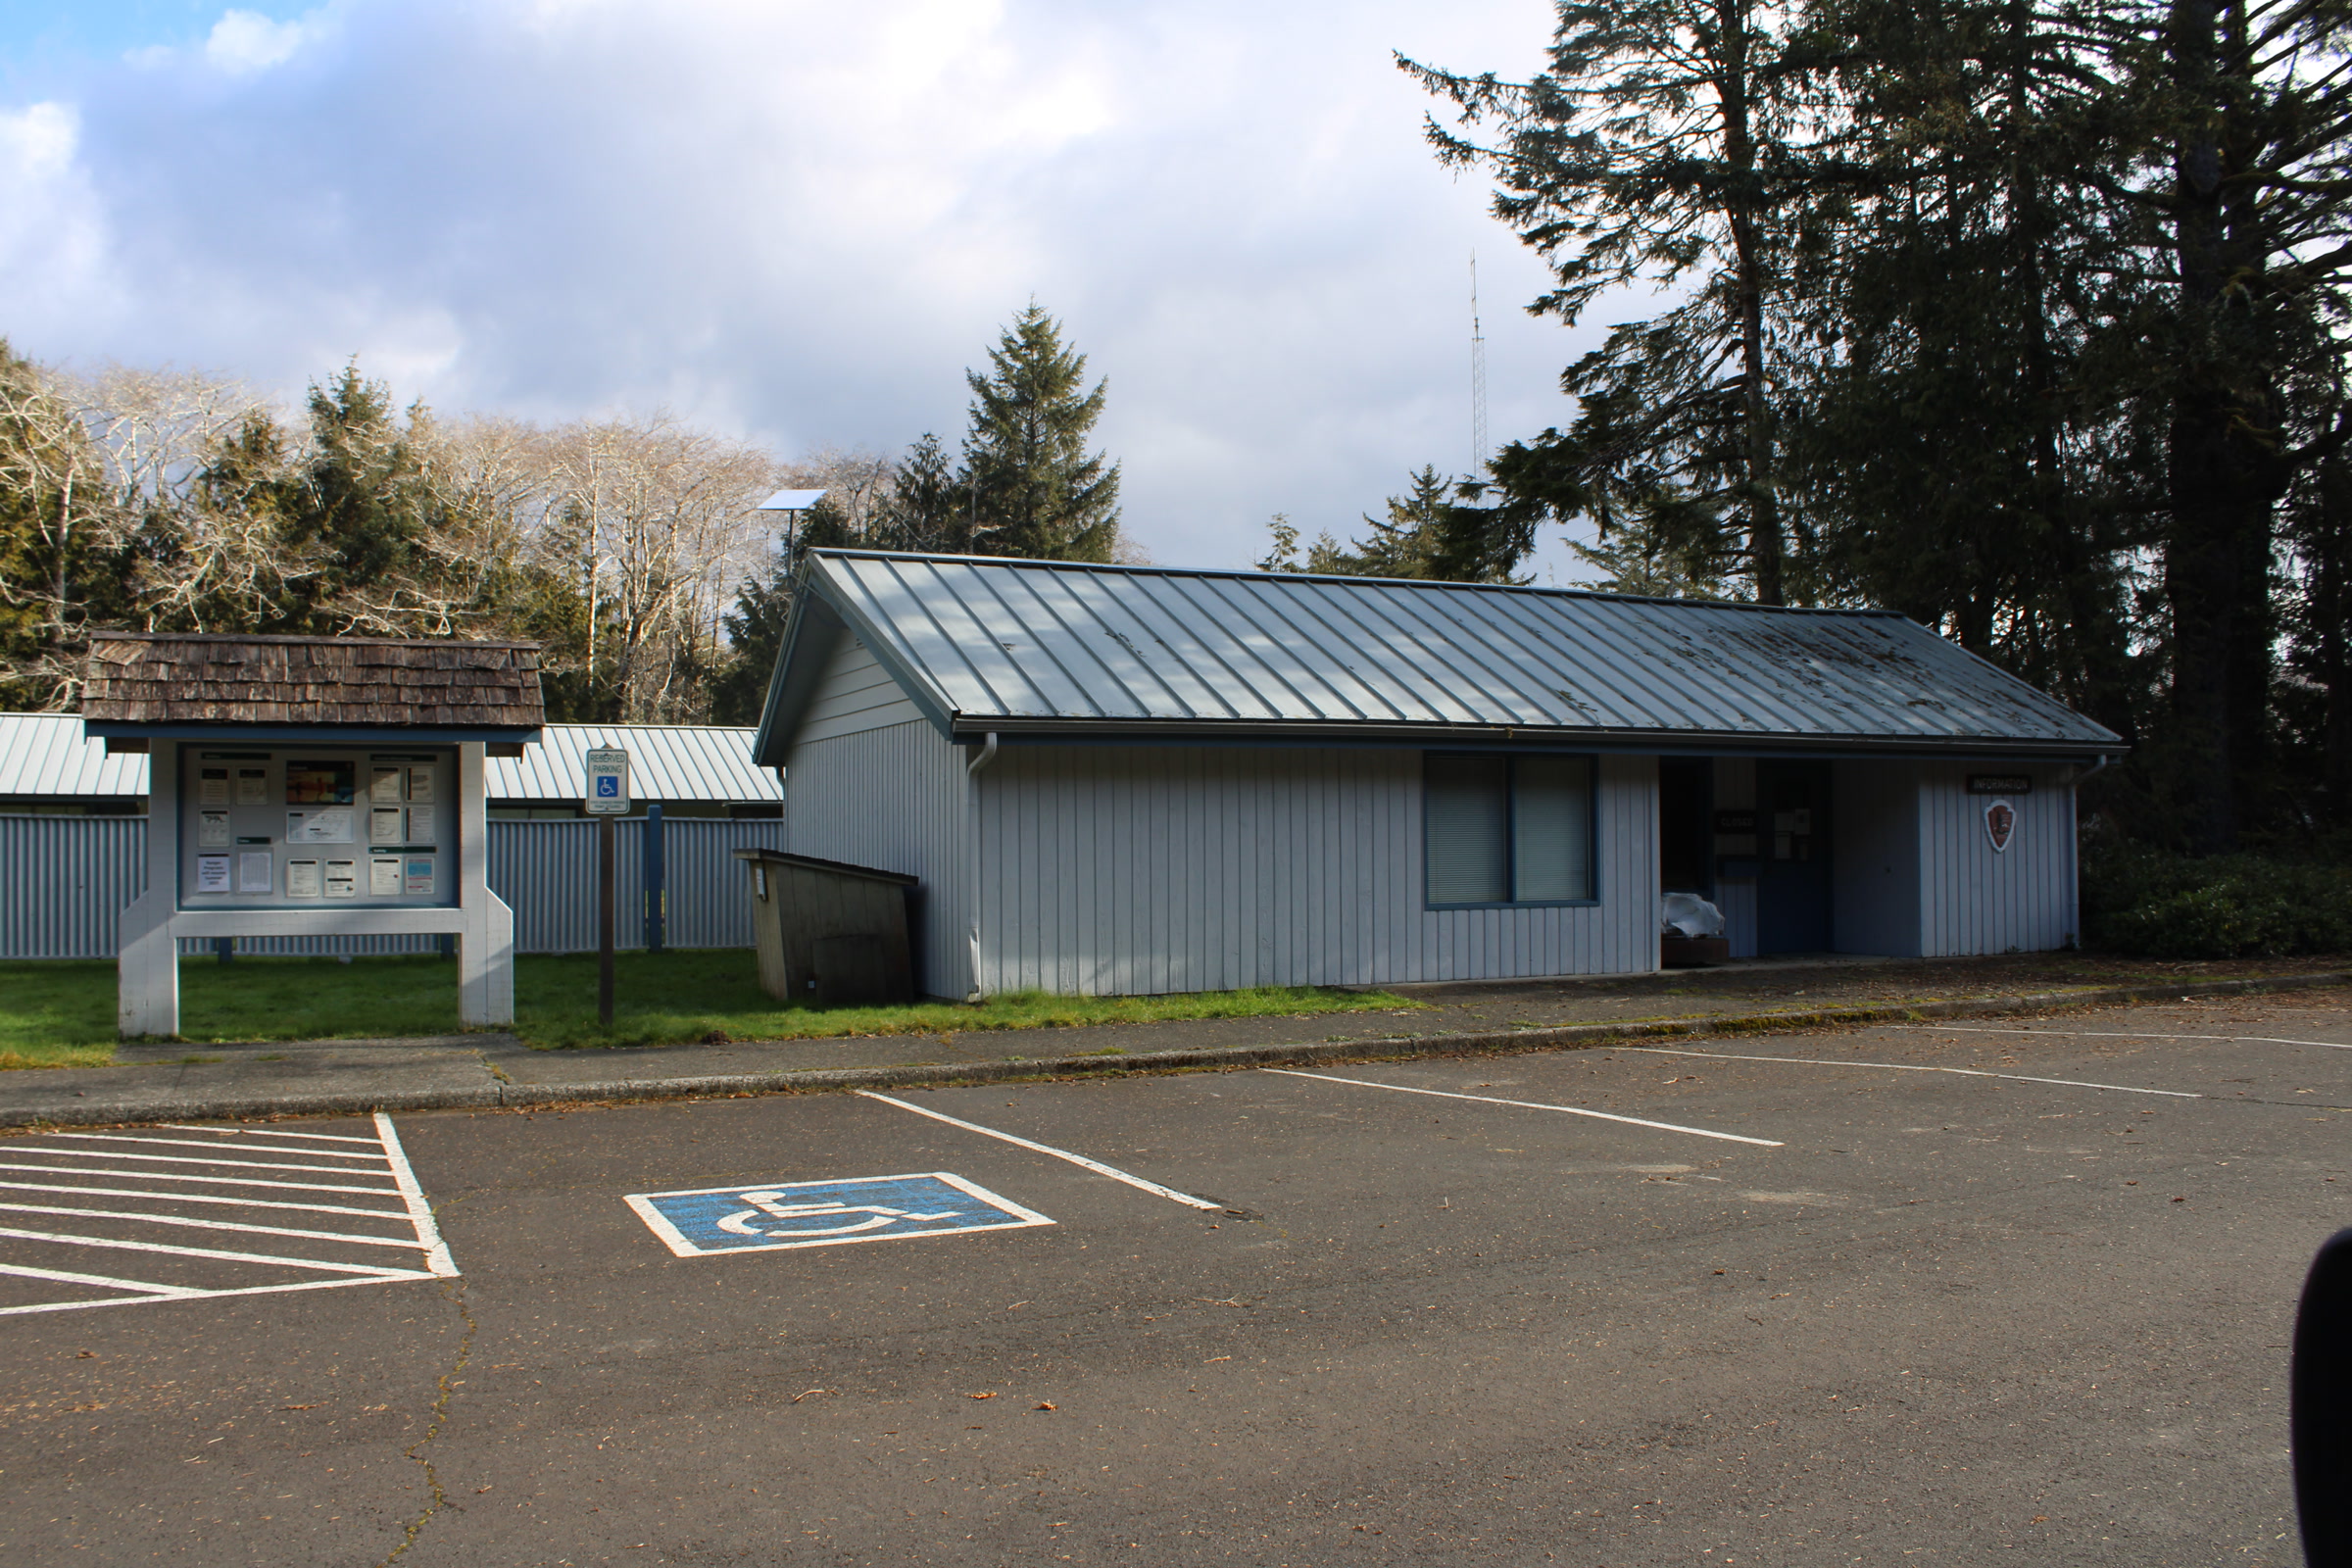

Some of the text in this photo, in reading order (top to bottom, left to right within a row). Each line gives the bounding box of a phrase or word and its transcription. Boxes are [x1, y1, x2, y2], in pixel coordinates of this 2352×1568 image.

[590, 754, 625, 762] RESERVED
[1974, 778, 2028, 789] INFORMATION
[1720, 817, 1754, 827] CLOSED
